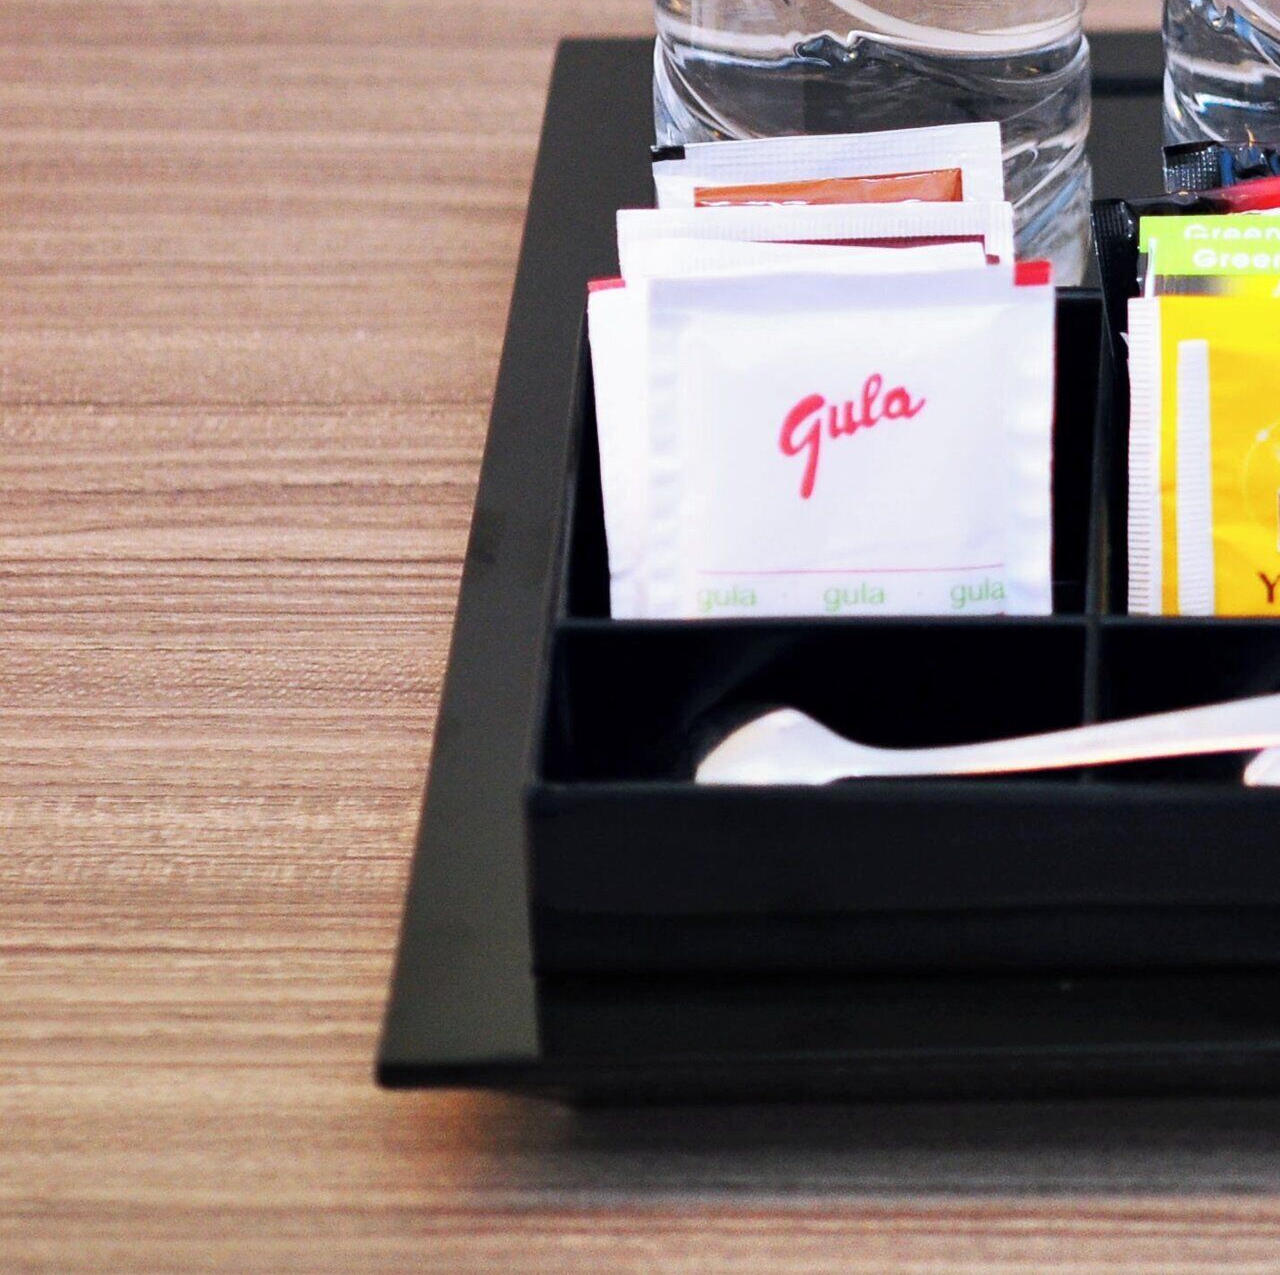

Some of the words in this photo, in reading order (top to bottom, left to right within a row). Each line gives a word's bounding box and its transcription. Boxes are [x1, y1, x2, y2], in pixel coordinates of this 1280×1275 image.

[697, 583, 757, 613] gula
[823, 581, 884, 613] gula
[950, 577, 1006, 608] gula
